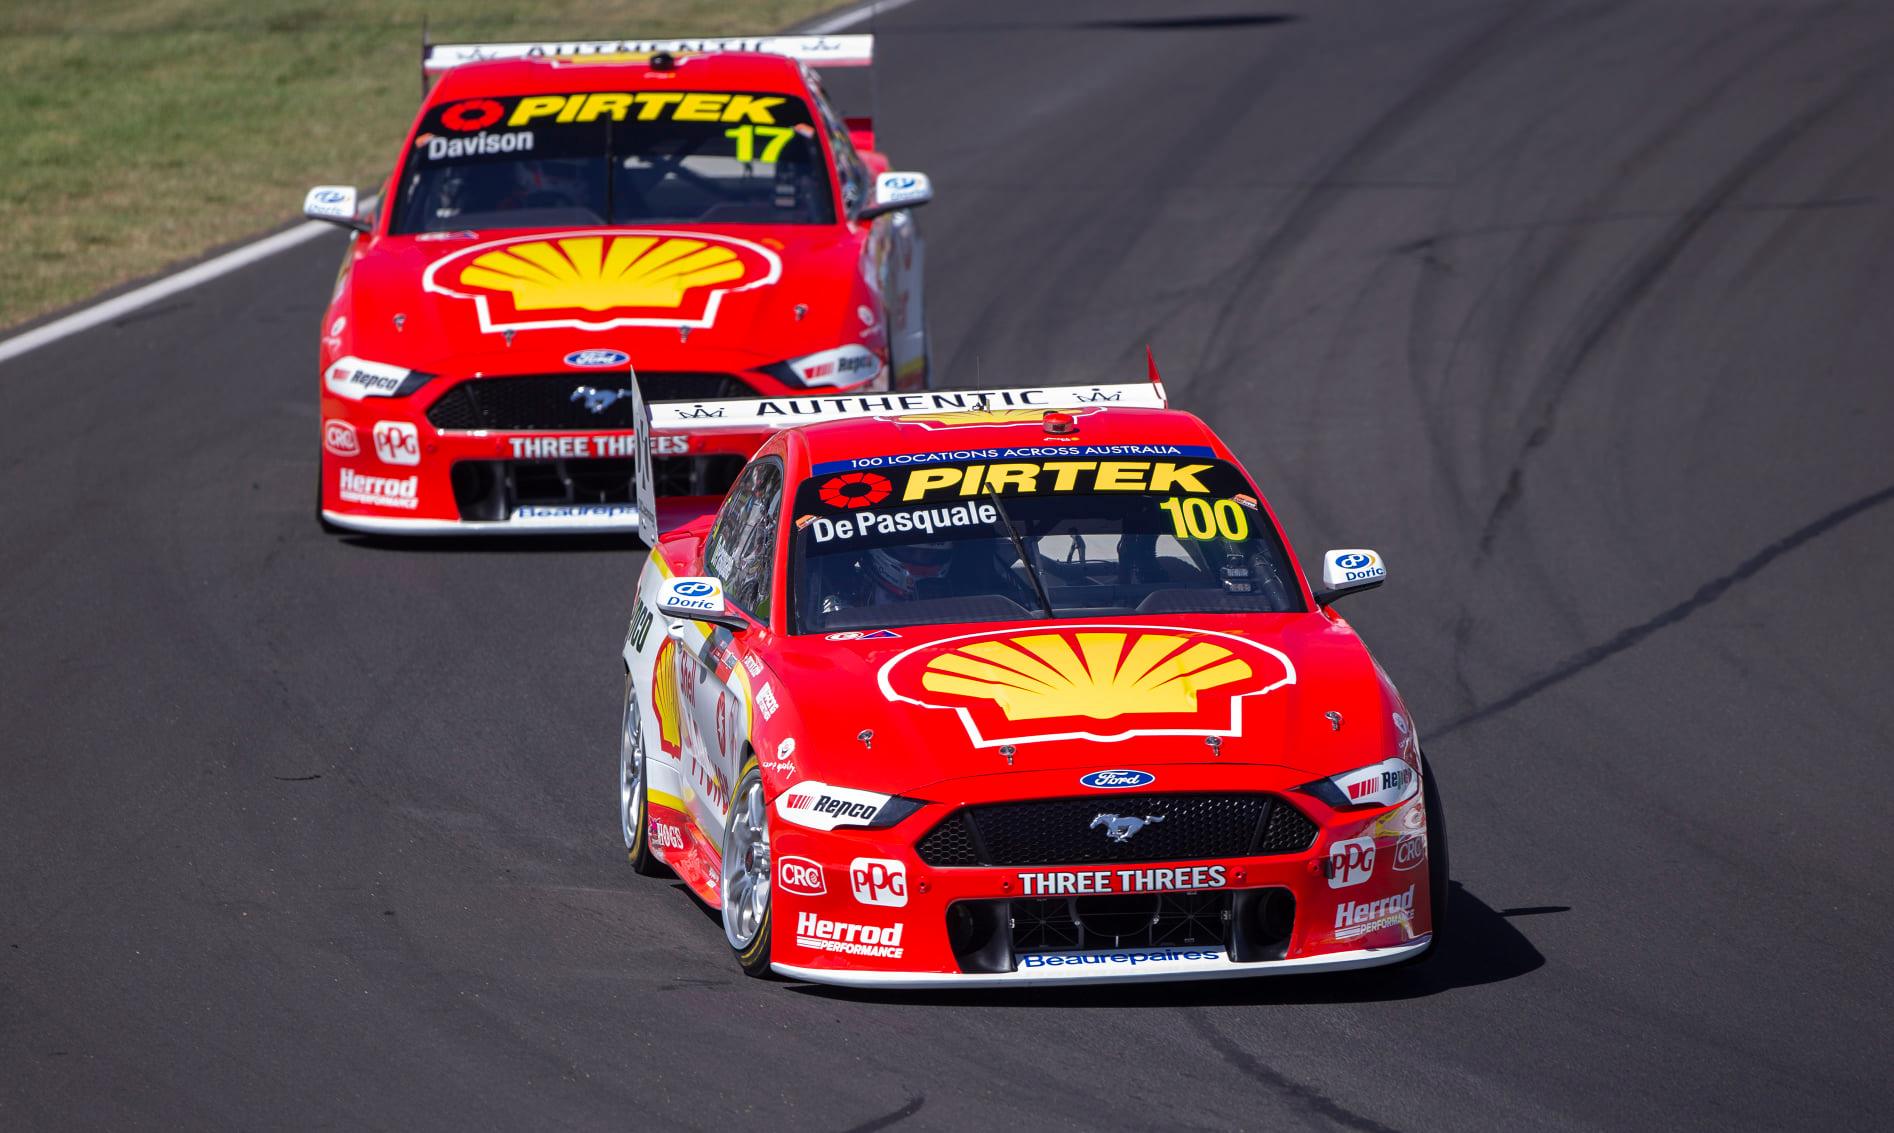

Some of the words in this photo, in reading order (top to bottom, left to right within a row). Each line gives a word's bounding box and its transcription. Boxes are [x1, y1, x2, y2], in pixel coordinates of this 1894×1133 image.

[507, 92, 787, 127] PIRTEK
[428, 130, 534, 160] Davison
[725, 125, 796, 162] 17
[575, 350, 617, 365] Ford
[350, 370, 399, 390] Repco
[756, 389, 1049, 416] AUTHENTIC
[327, 428, 355, 448] CRC
[377, 427, 416, 458] PPG
[508, 437, 590, 458] THREE
[851, 457, 883, 469] 100
[888, 448, 998, 464] LOCATIONS
[1004, 446, 1079, 458] ACROSS
[1085, 444, 1181, 456] AUSTRALIA
[340, 467, 418, 497] Herrod
[902, 461, 1215, 501] PIRTEK
[812, 518, 854, 543] De
[855, 501, 997, 537] Pasquale
[1159, 496, 1249, 541] 100
[1345, 567, 1385, 581] Doric
[667, 596, 715, 609] Doric
[1094, 771, 1140, 785] Ford
[813, 795, 878, 820] Repco
[1332, 844, 1373, 884] PPG
[1397, 839, 1423, 863] CRC
[782, 864, 821, 888] CRC
[852, 863, 905, 901] PPG
[1018, 871, 1112, 895] THREE
[1116, 865, 1226, 893] THREES
[1334, 884, 1415, 928] Herrod
[796, 911, 903, 947] Herrod
[1360, 908, 1416, 934] PERFORMANCE
[819, 940, 904, 958] PERFORMANCE
[1024, 948, 1220, 968] Beaurepaires
